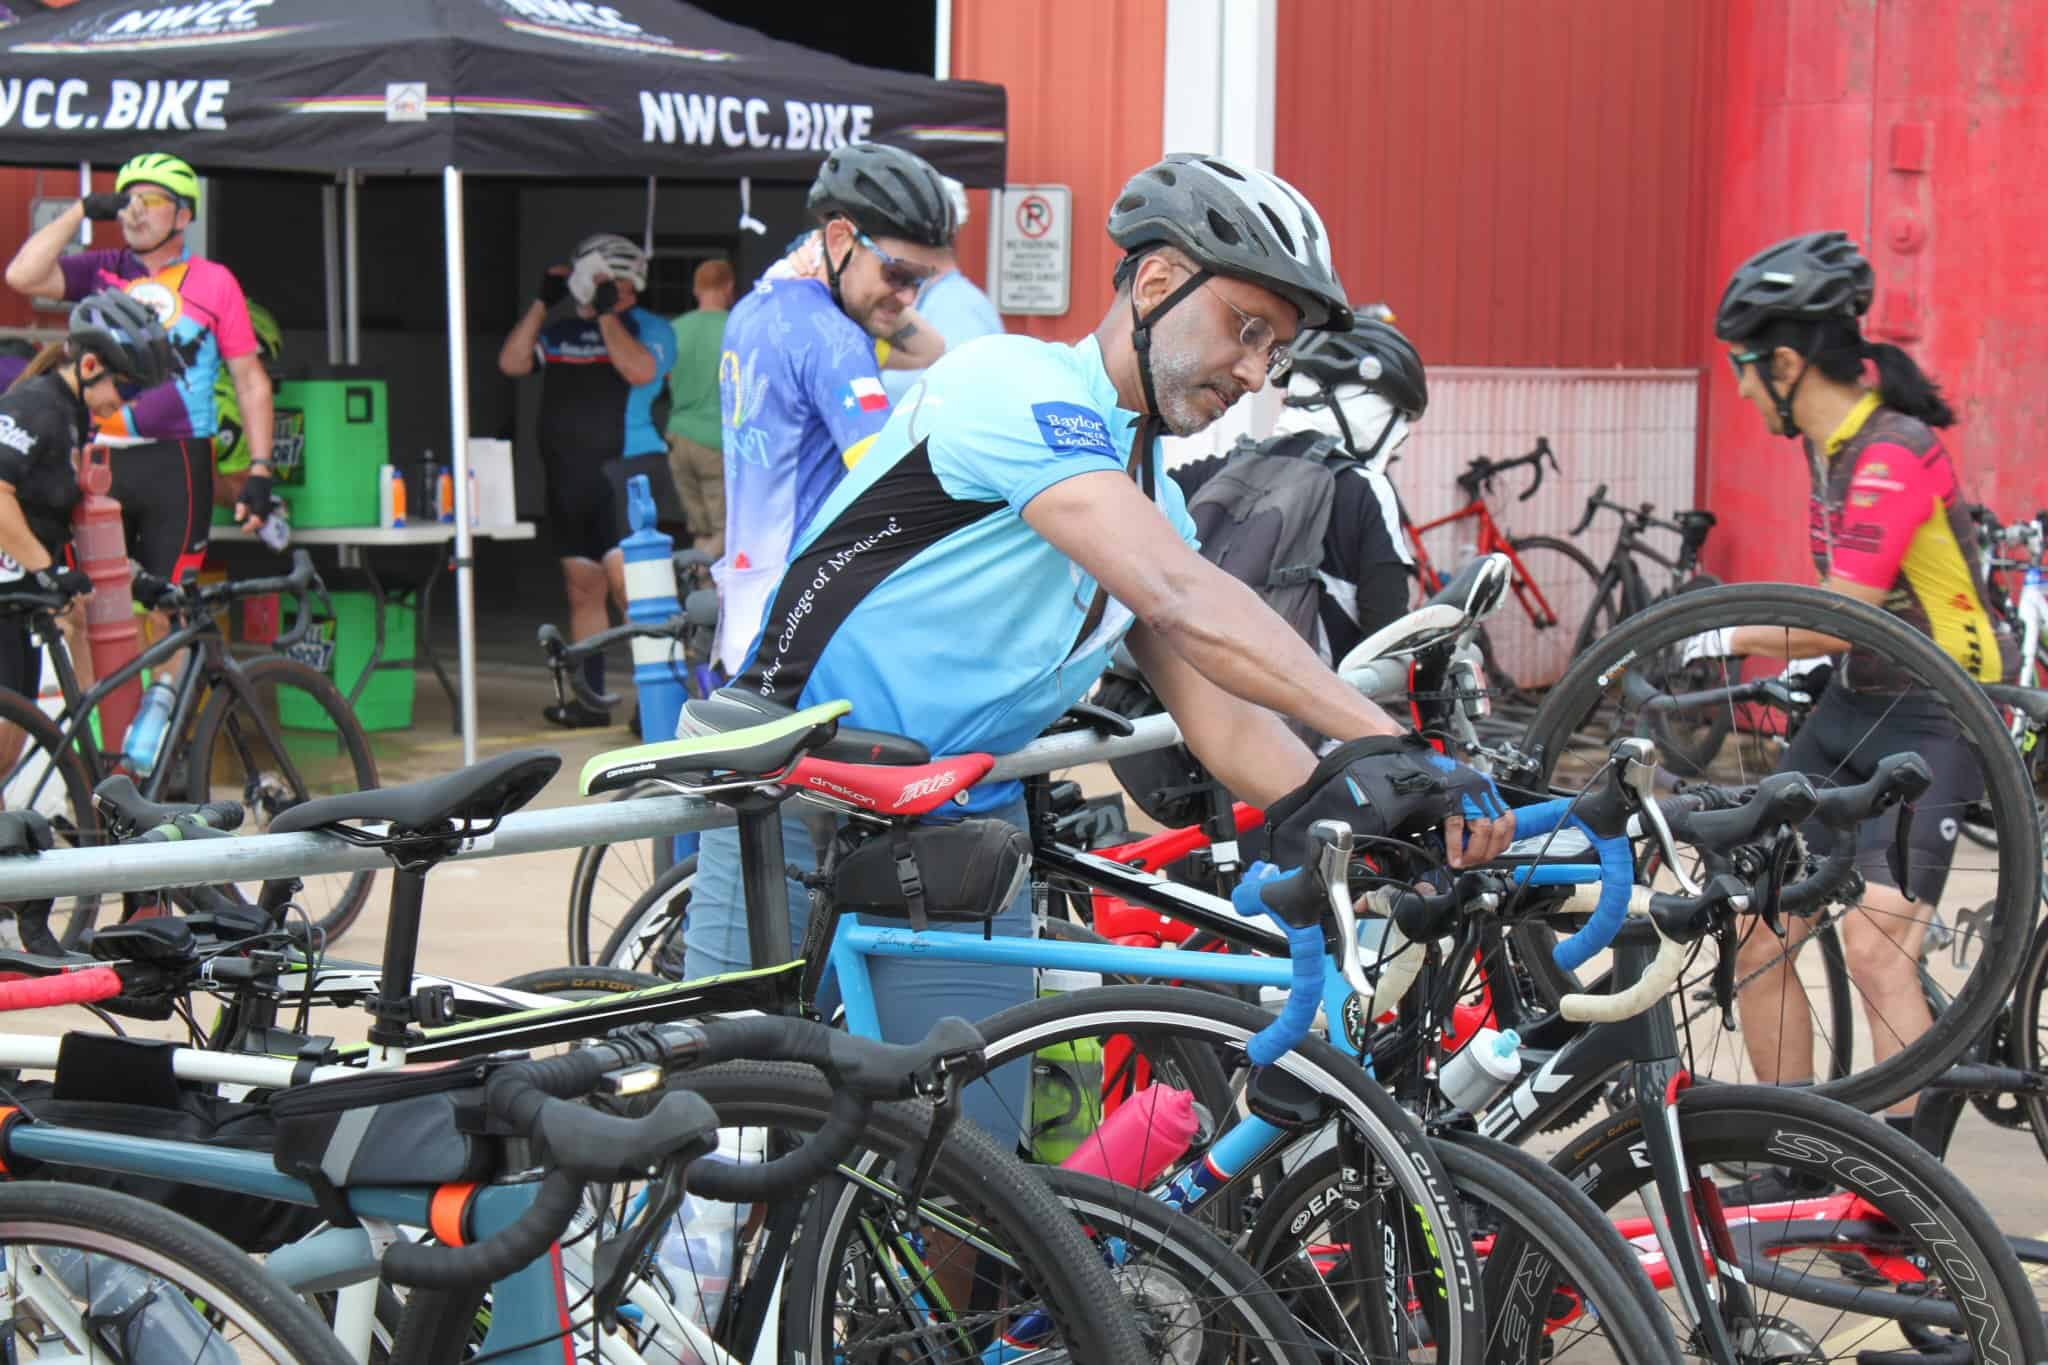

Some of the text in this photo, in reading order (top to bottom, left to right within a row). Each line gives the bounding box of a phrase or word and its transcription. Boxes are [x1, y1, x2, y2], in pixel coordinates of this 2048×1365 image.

[639, 91, 874, 150] NWCC.BIKE
[1046, 414, 1103, 431] Baylor
[760, 657, 782, 697] aylor
[778, 588, 815, 653] College
[812, 566, 831, 590] of
[809, 775, 877, 807] drakon
[1308, 1184, 1344, 1218] EA
[1410, 1152, 1475, 1313] LUGANO
[1768, 1129, 2011, 1365] NOLDS
